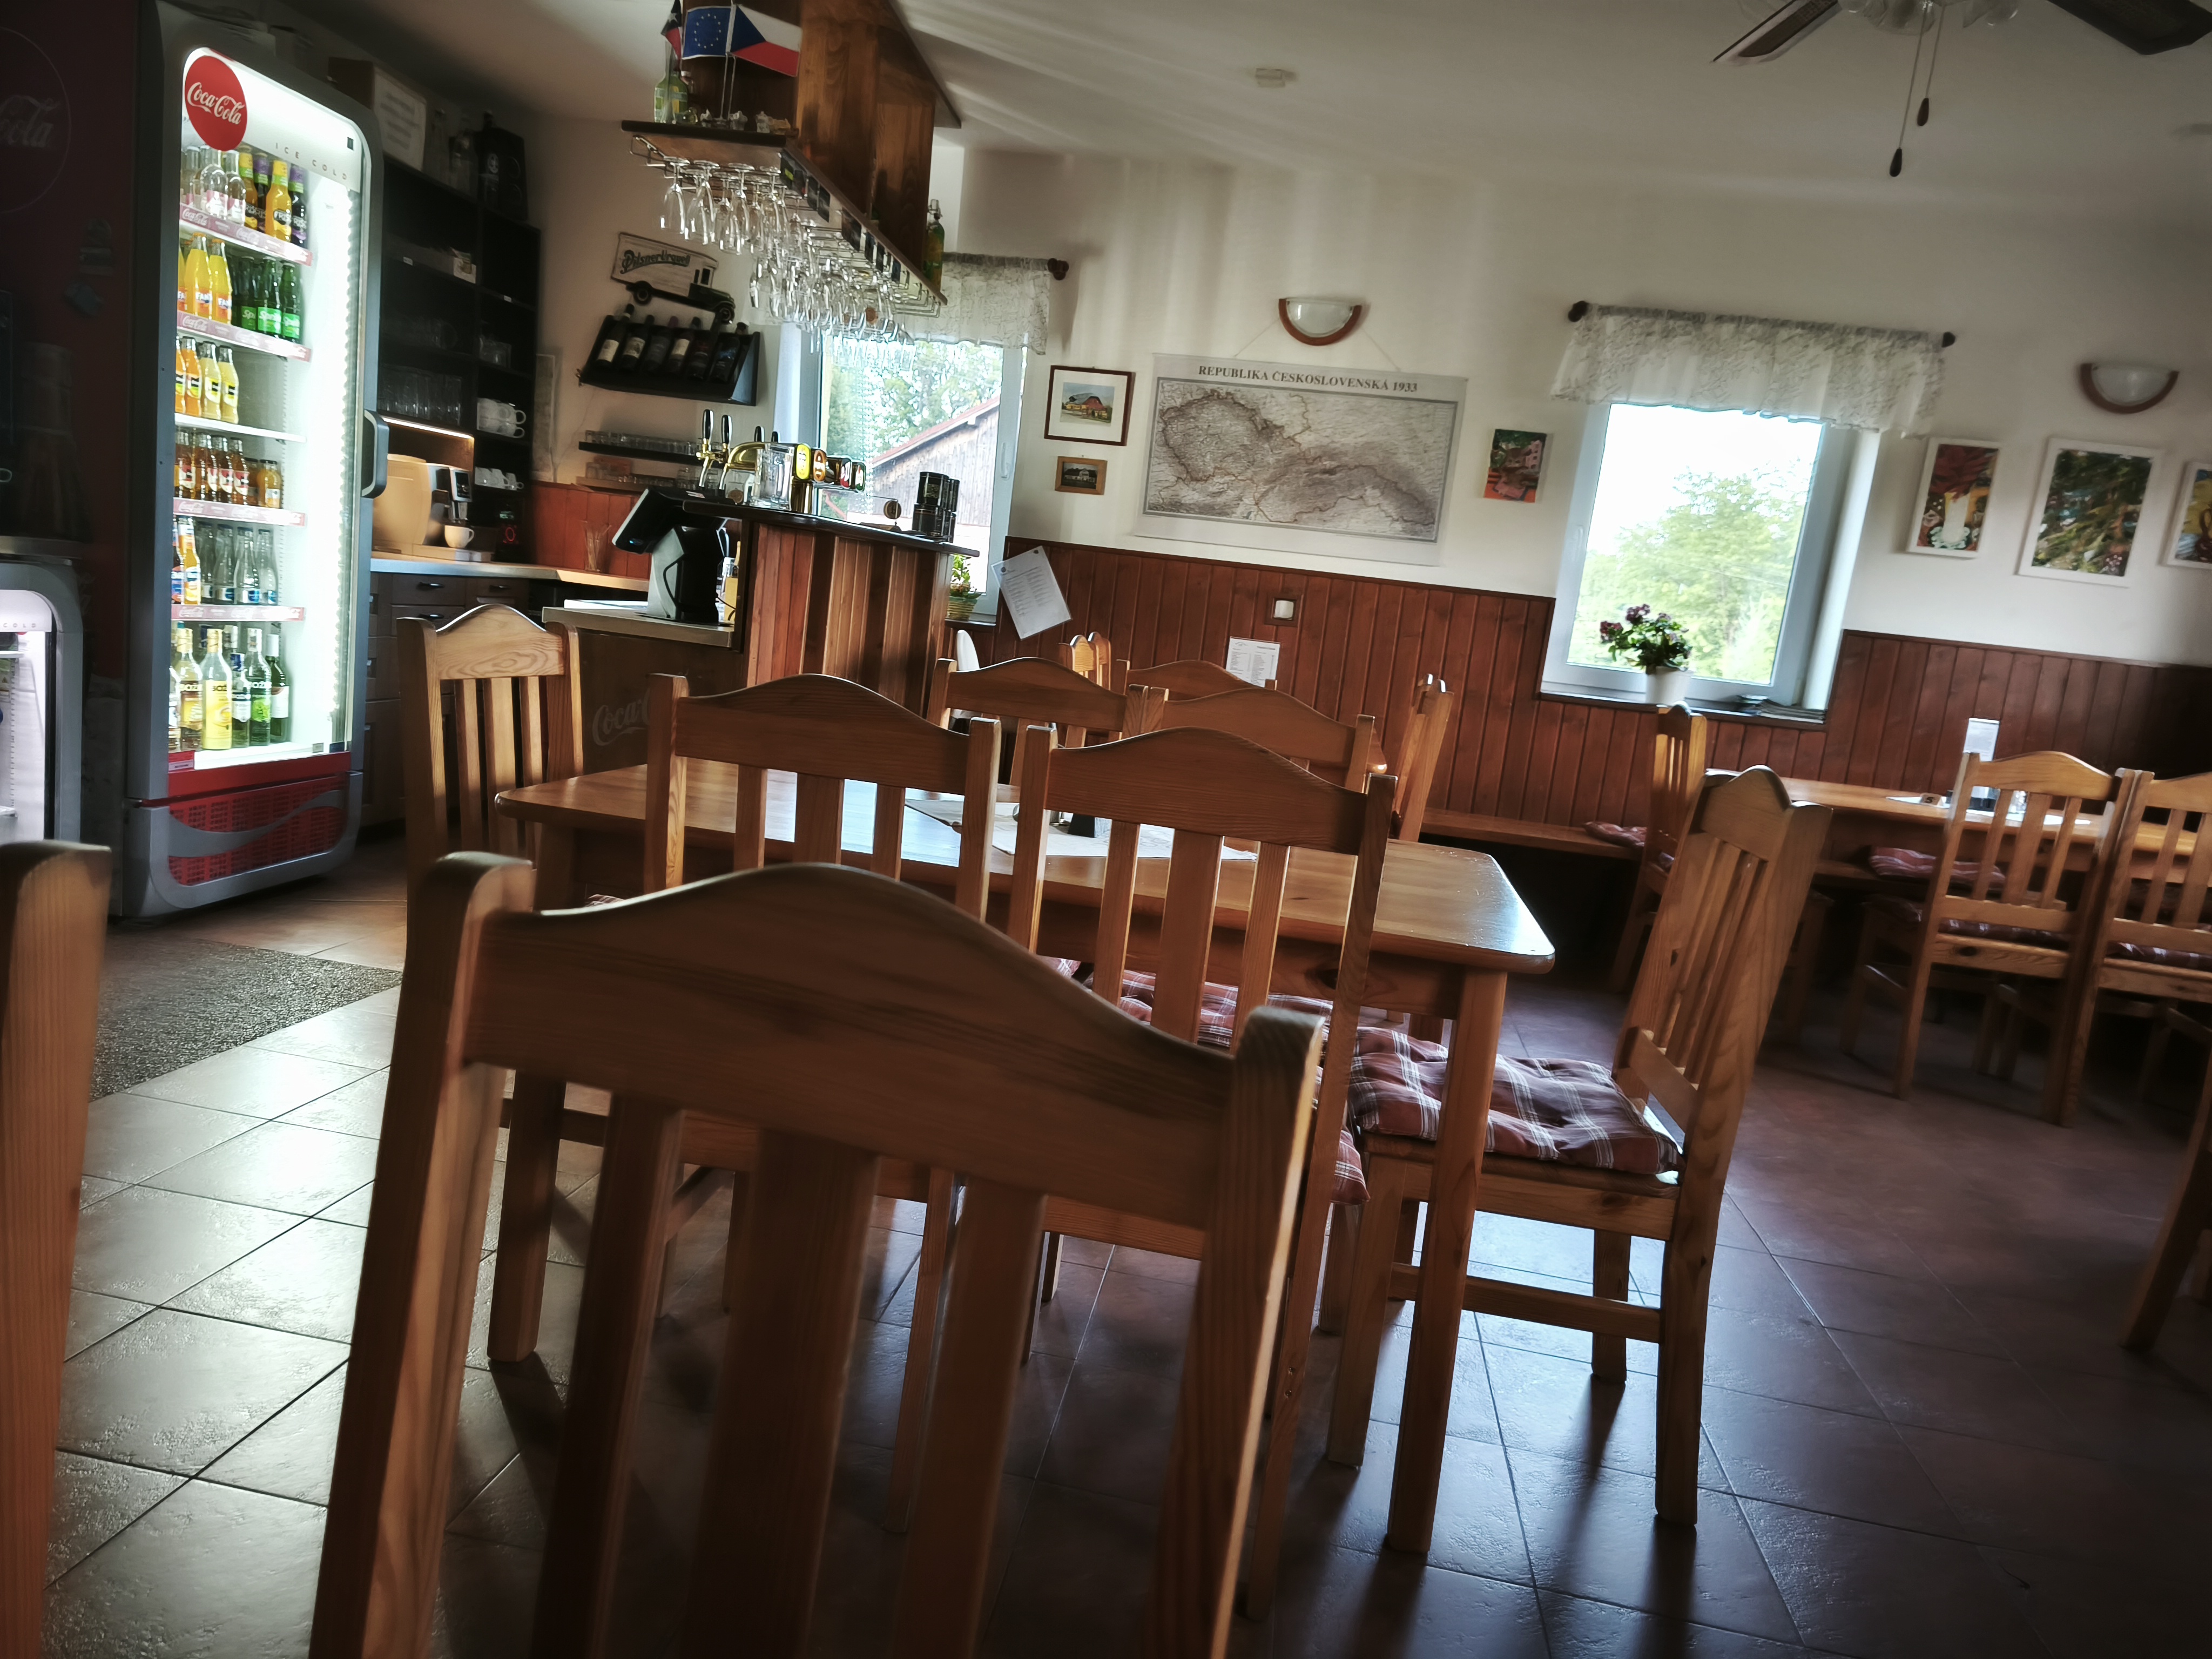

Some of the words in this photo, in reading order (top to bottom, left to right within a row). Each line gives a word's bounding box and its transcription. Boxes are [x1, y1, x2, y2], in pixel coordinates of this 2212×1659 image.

[187, 82, 245, 125] Coca-Cola
[275, 143, 299, 159] ICE
[312, 159, 347, 180] COLD
[1198, 366, 1268, 380] REPUBLIKA
[1272, 370, 1388, 390] ČESKOSLOVENSKÁ
[1393, 382, 1418, 392] 1933
